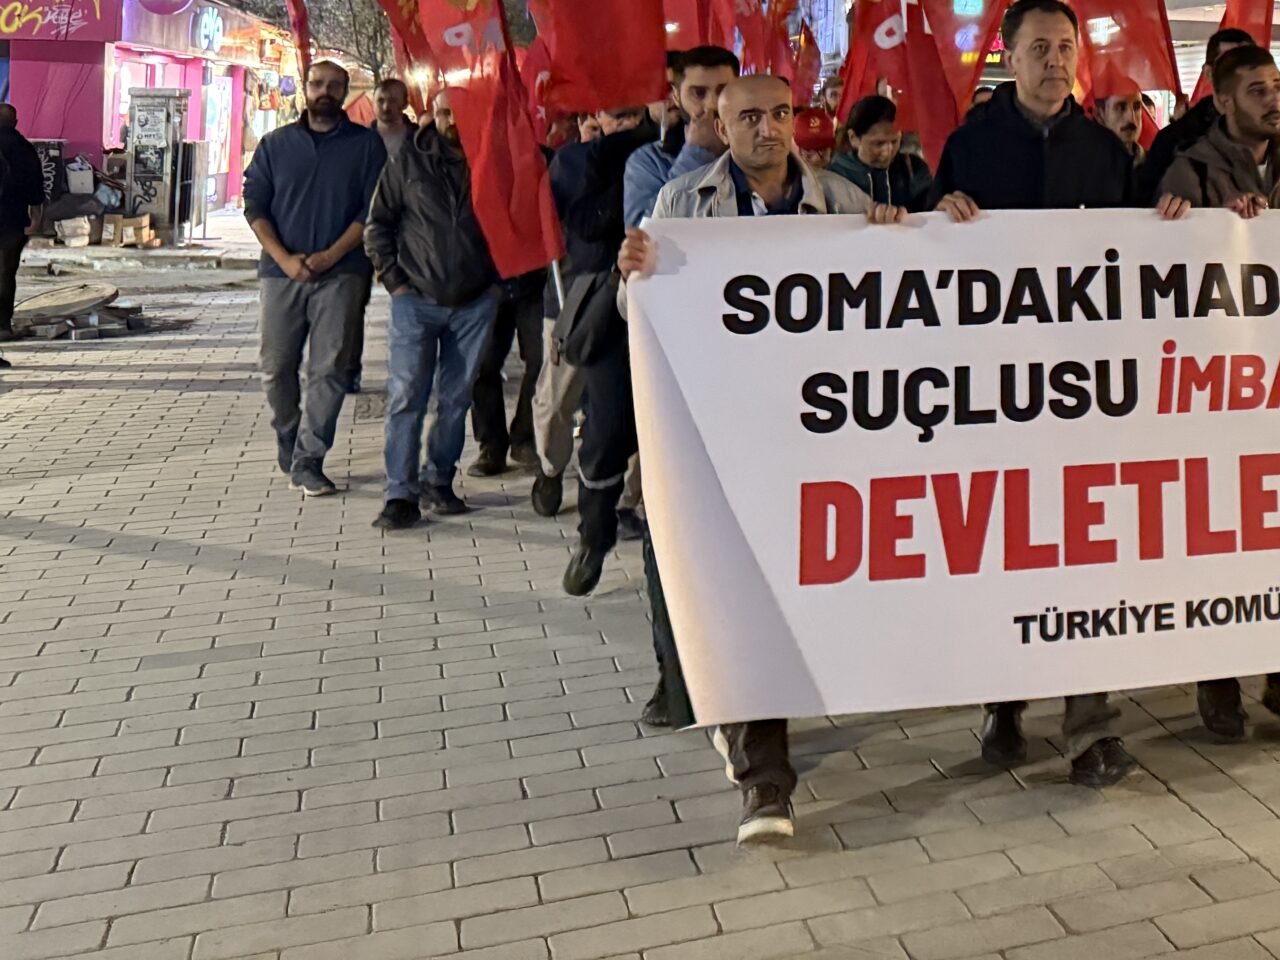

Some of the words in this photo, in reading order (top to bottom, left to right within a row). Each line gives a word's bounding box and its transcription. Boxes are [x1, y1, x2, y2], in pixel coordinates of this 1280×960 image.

[200, 7, 223, 53] eve
[721, 248, 1123, 335] SOMA'DAKİ
[799, 358, 1138, 443] SUÇLUSU
[1013, 599, 1176, 645] TÜRKİYE
